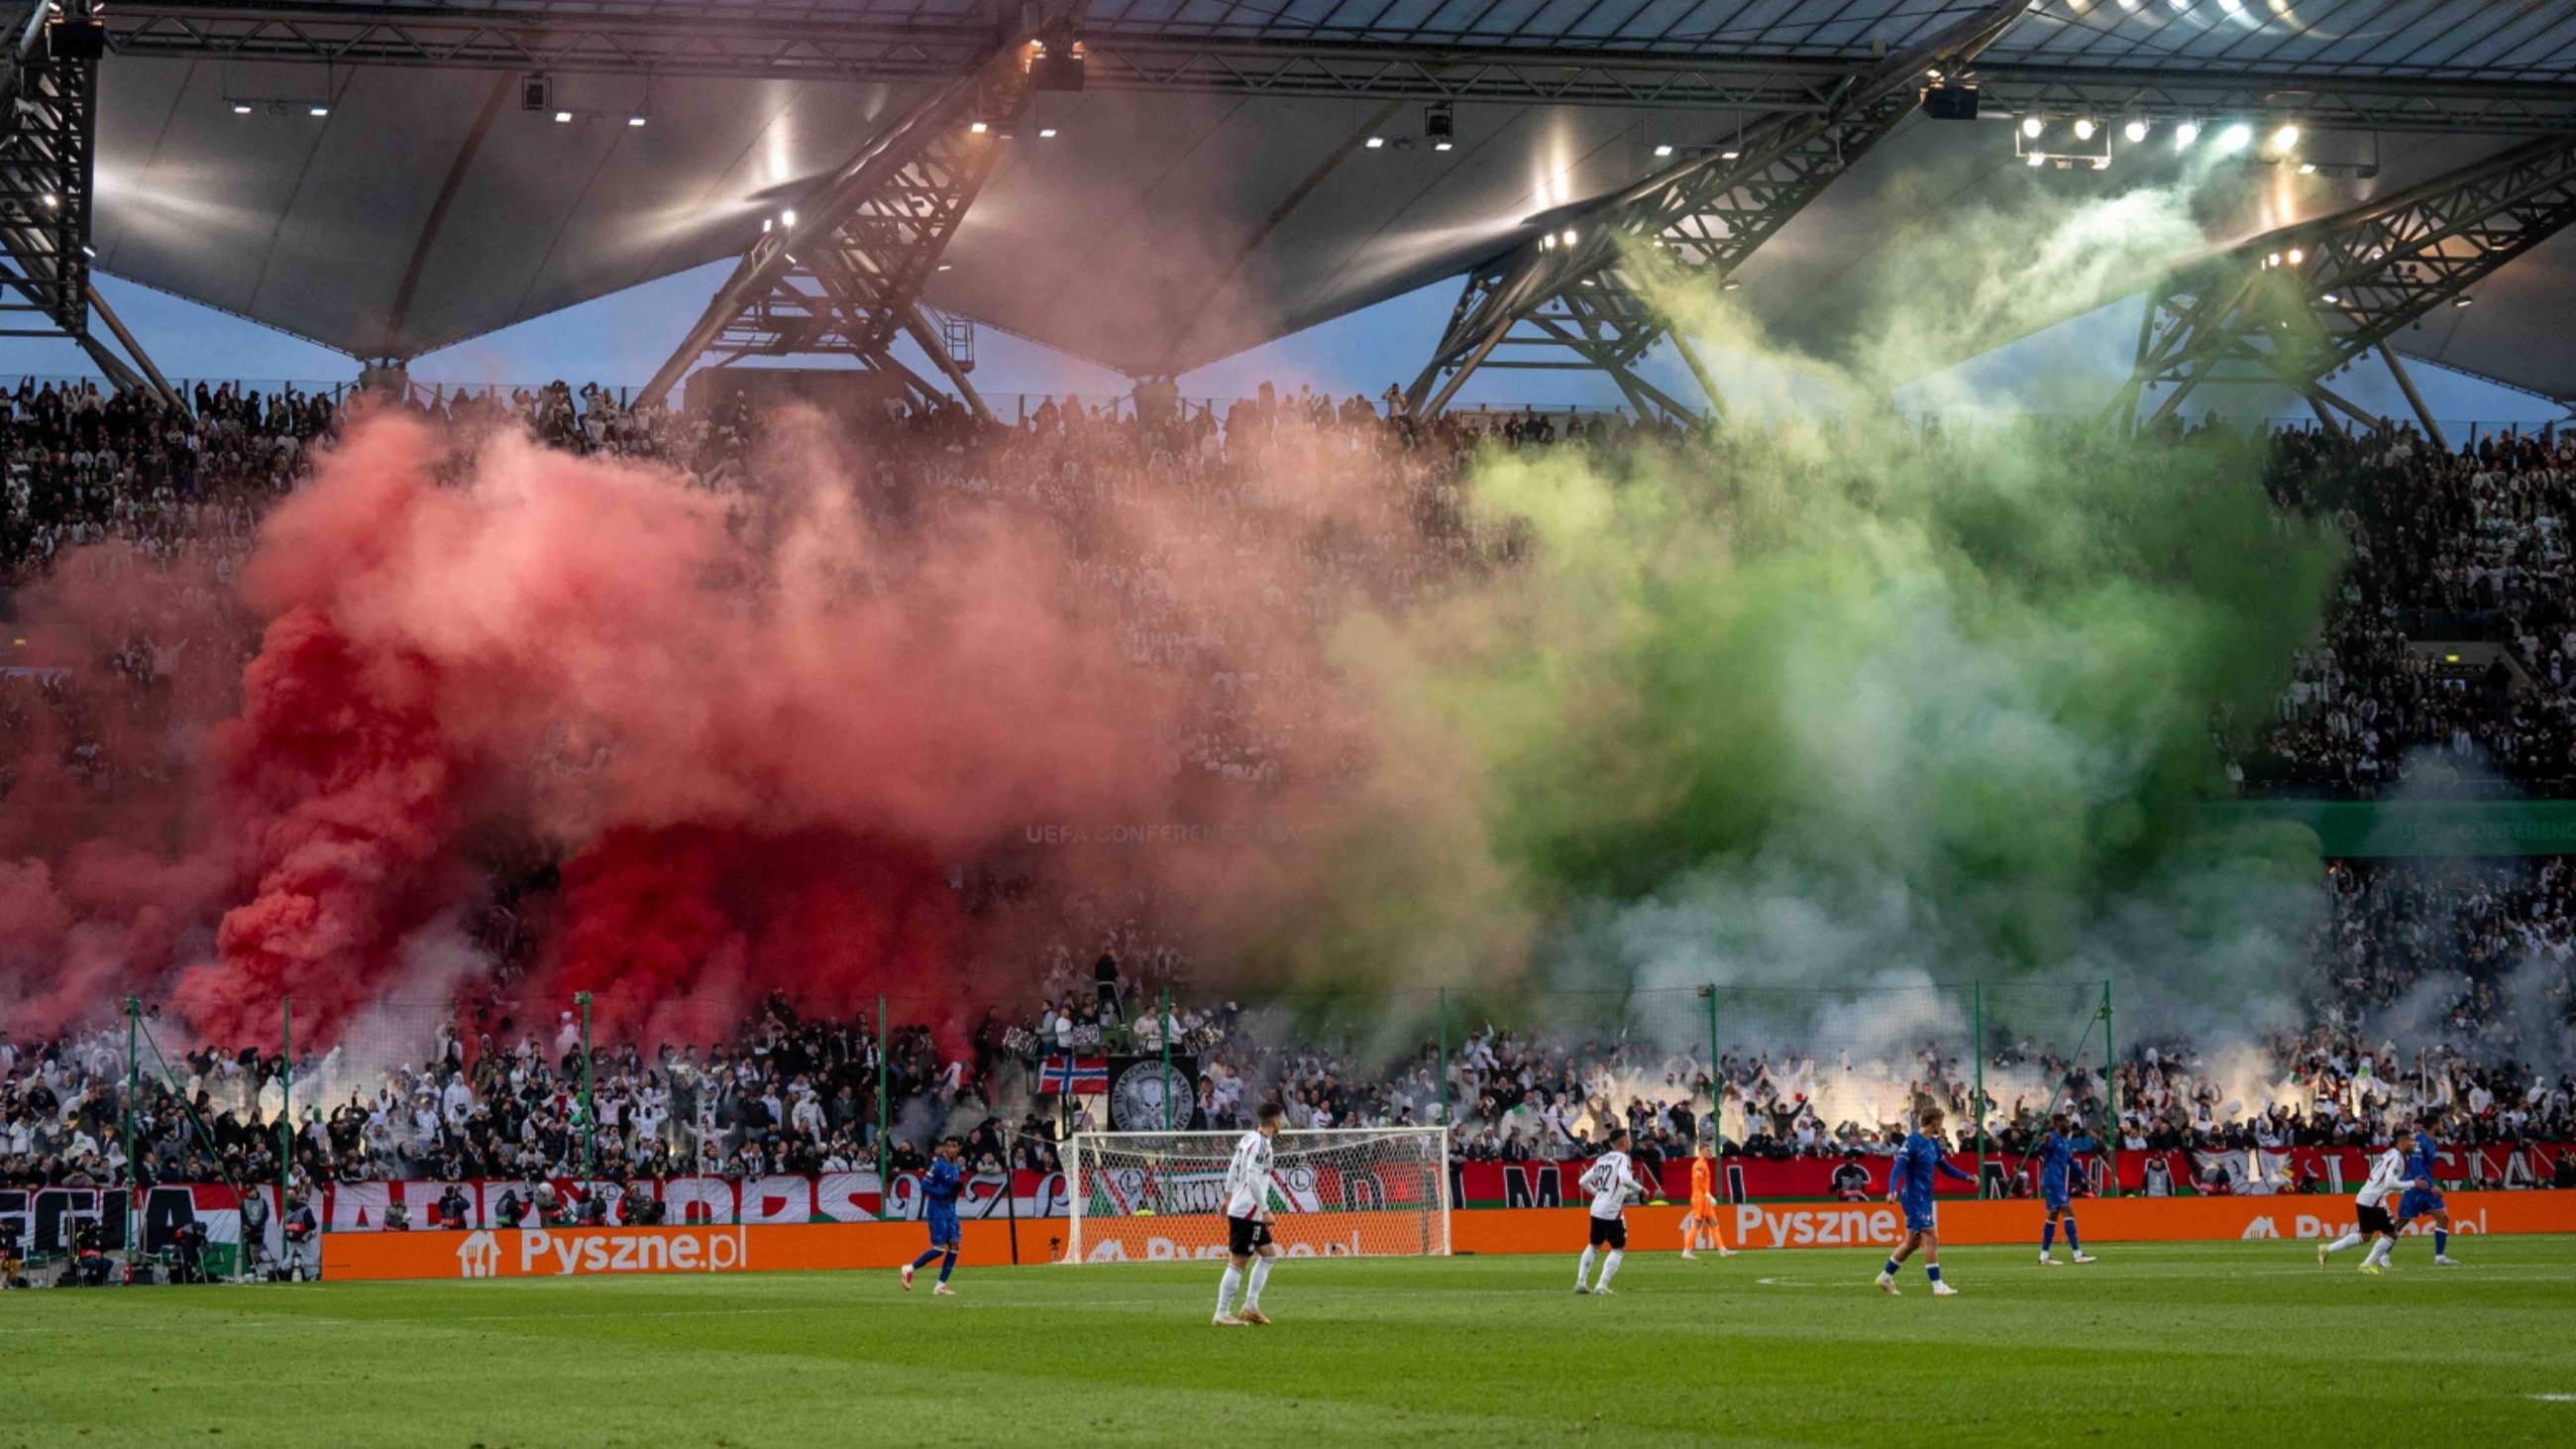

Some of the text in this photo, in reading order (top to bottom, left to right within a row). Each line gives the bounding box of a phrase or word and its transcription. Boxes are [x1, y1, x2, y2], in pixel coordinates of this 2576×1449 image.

[1025, 824, 1090, 844] UEFA
[1737, 1200, 1937, 1248] Pyszne.l
[521, 1225, 746, 1275] Pyszne.pl
